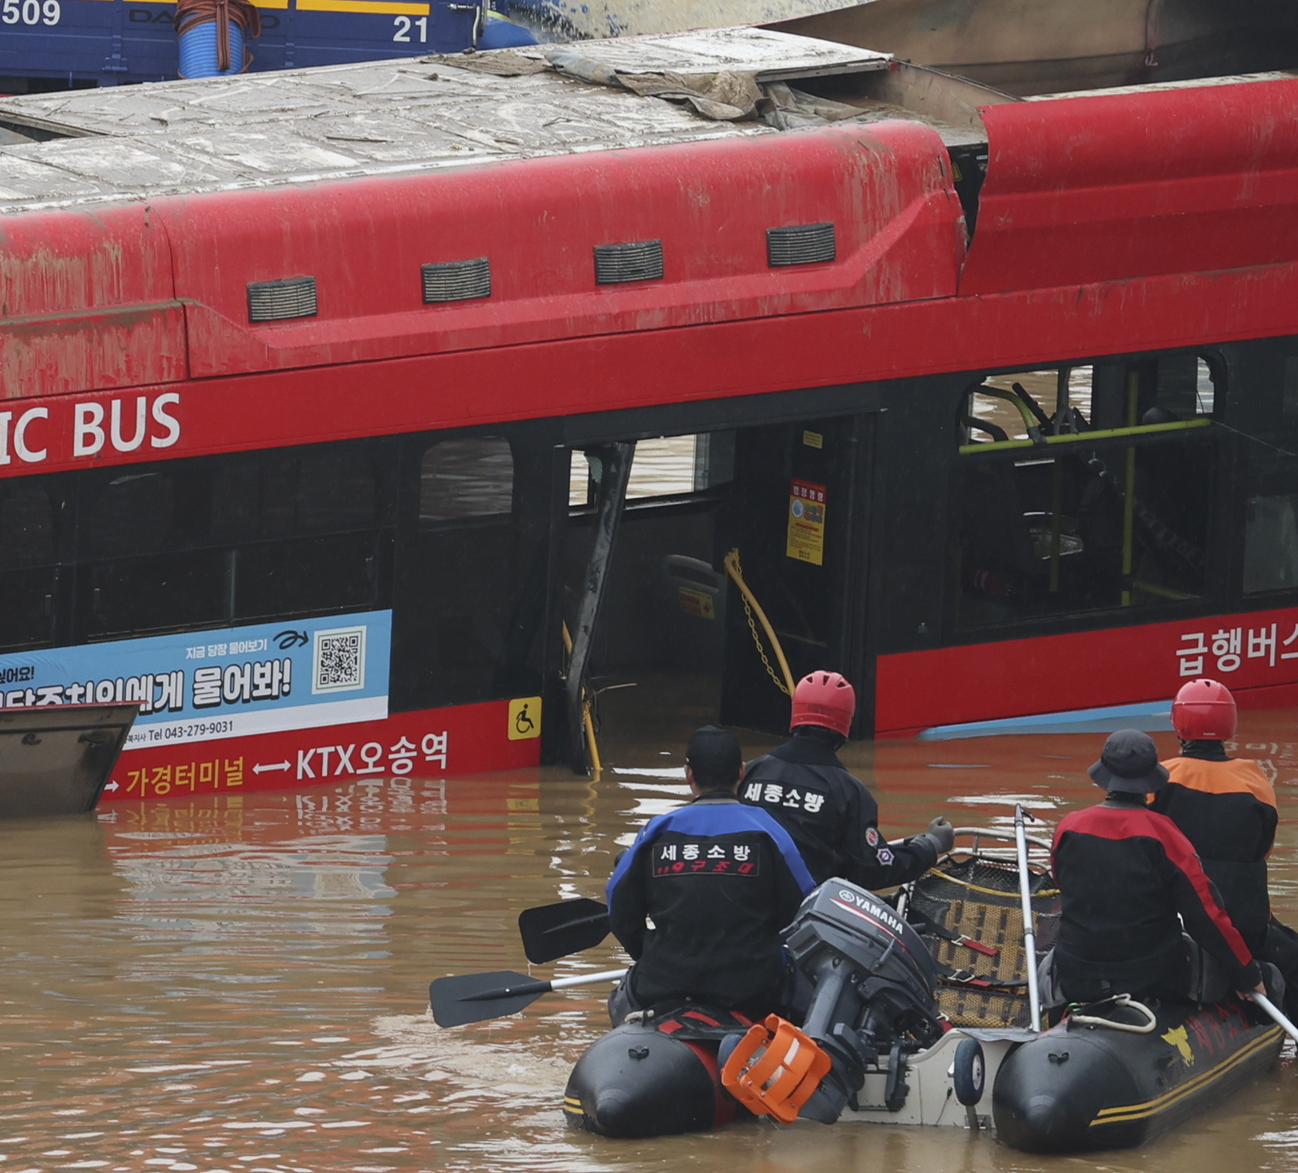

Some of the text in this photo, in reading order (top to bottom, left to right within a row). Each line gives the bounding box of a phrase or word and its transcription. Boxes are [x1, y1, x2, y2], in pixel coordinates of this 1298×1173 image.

[129, 9, 280, 29] DAO
[392, 15, 428, 43] 21
[73, 392, 181, 457] BUS
[186, 643, 205, 659] 지금
[208, 642, 227, 657] 당장
[193, 658, 291, 709] 물어봐!
[148, 730, 162, 741] Tel
[165, 721, 233, 739] 043-279-9031
[126, 731, 448, 797] 가경터미널 KTX오송역
[744, 783, 824, 813] 세종소방
[660, 844, 751, 861] 세종소방
[855, 895, 903, 935] YAMAHA
